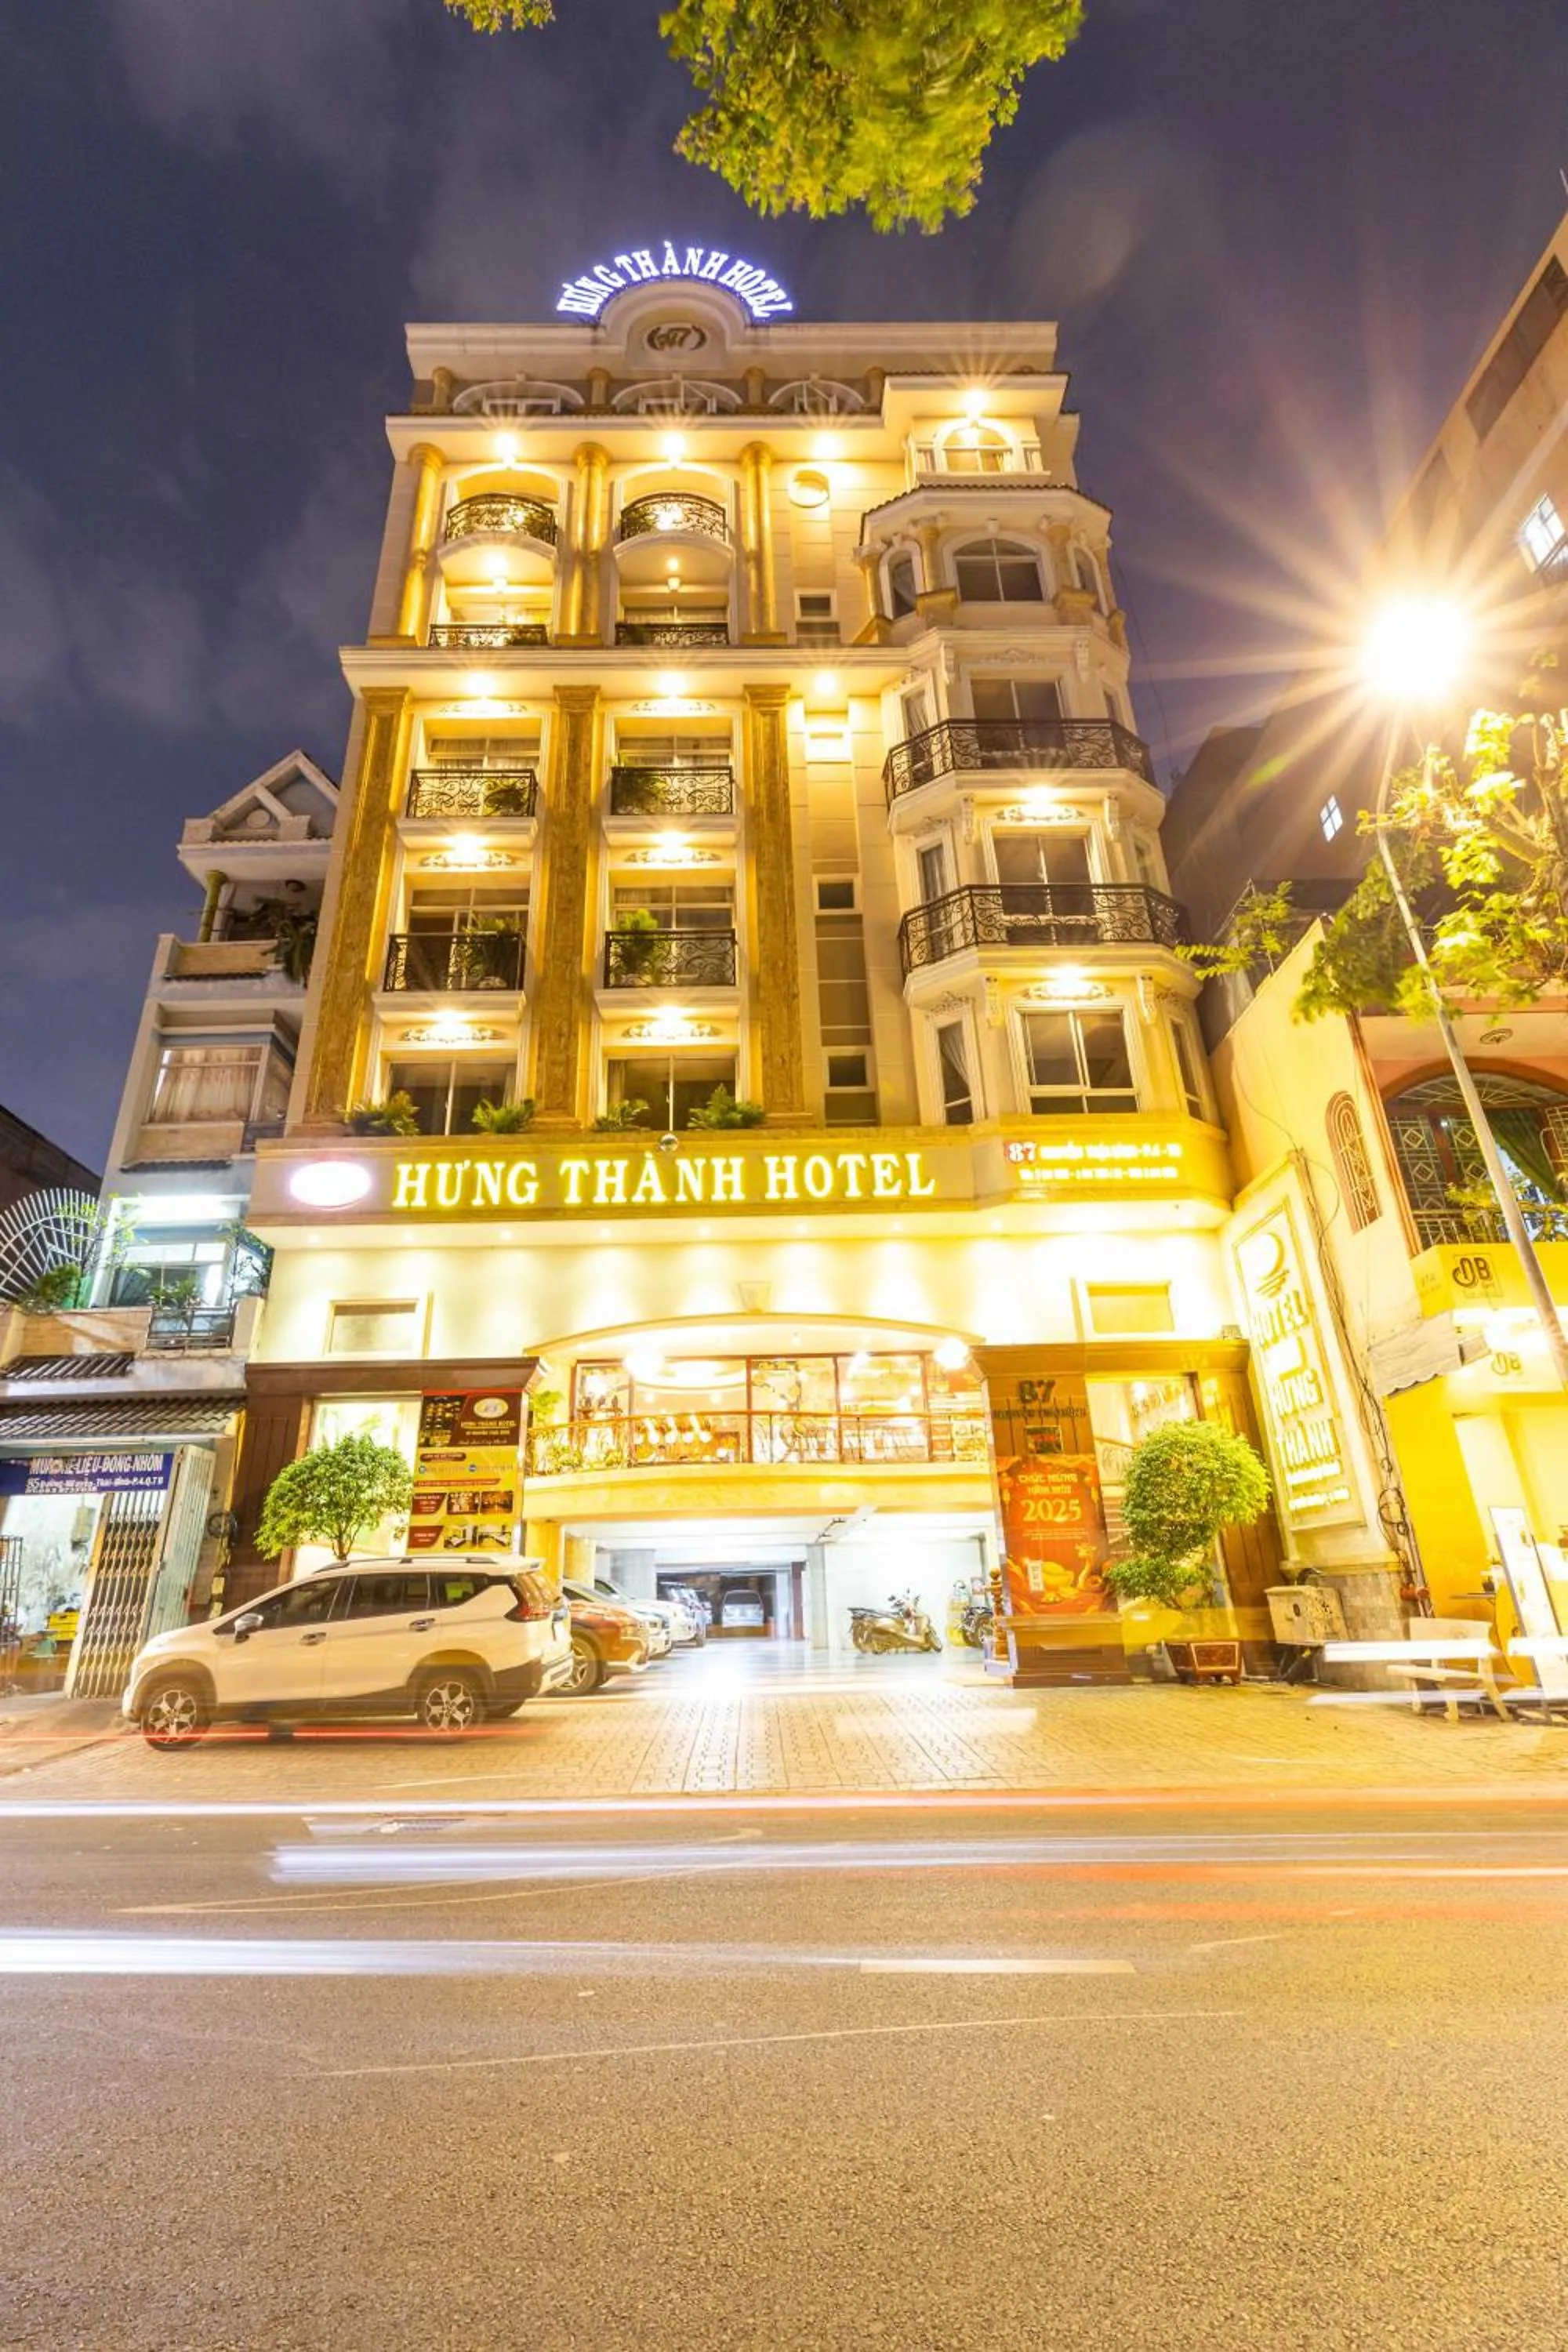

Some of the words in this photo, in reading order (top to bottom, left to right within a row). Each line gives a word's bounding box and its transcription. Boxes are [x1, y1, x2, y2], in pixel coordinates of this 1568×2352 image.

[556, 264, 626, 315] HƯNG
[614, 241, 729, 282] THÀNH
[717, 260, 793, 318] HOTEL
[1008, 1142, 1036, 1163] 87
[393, 1160, 539, 1207] HƯNG
[560, 1152, 746, 1203] THÀNH
[764, 1154, 936, 1200] HOTEL
[1276, 1419, 1338, 1467] THÀNH
[1021, 1498, 1082, 1523] 2025
